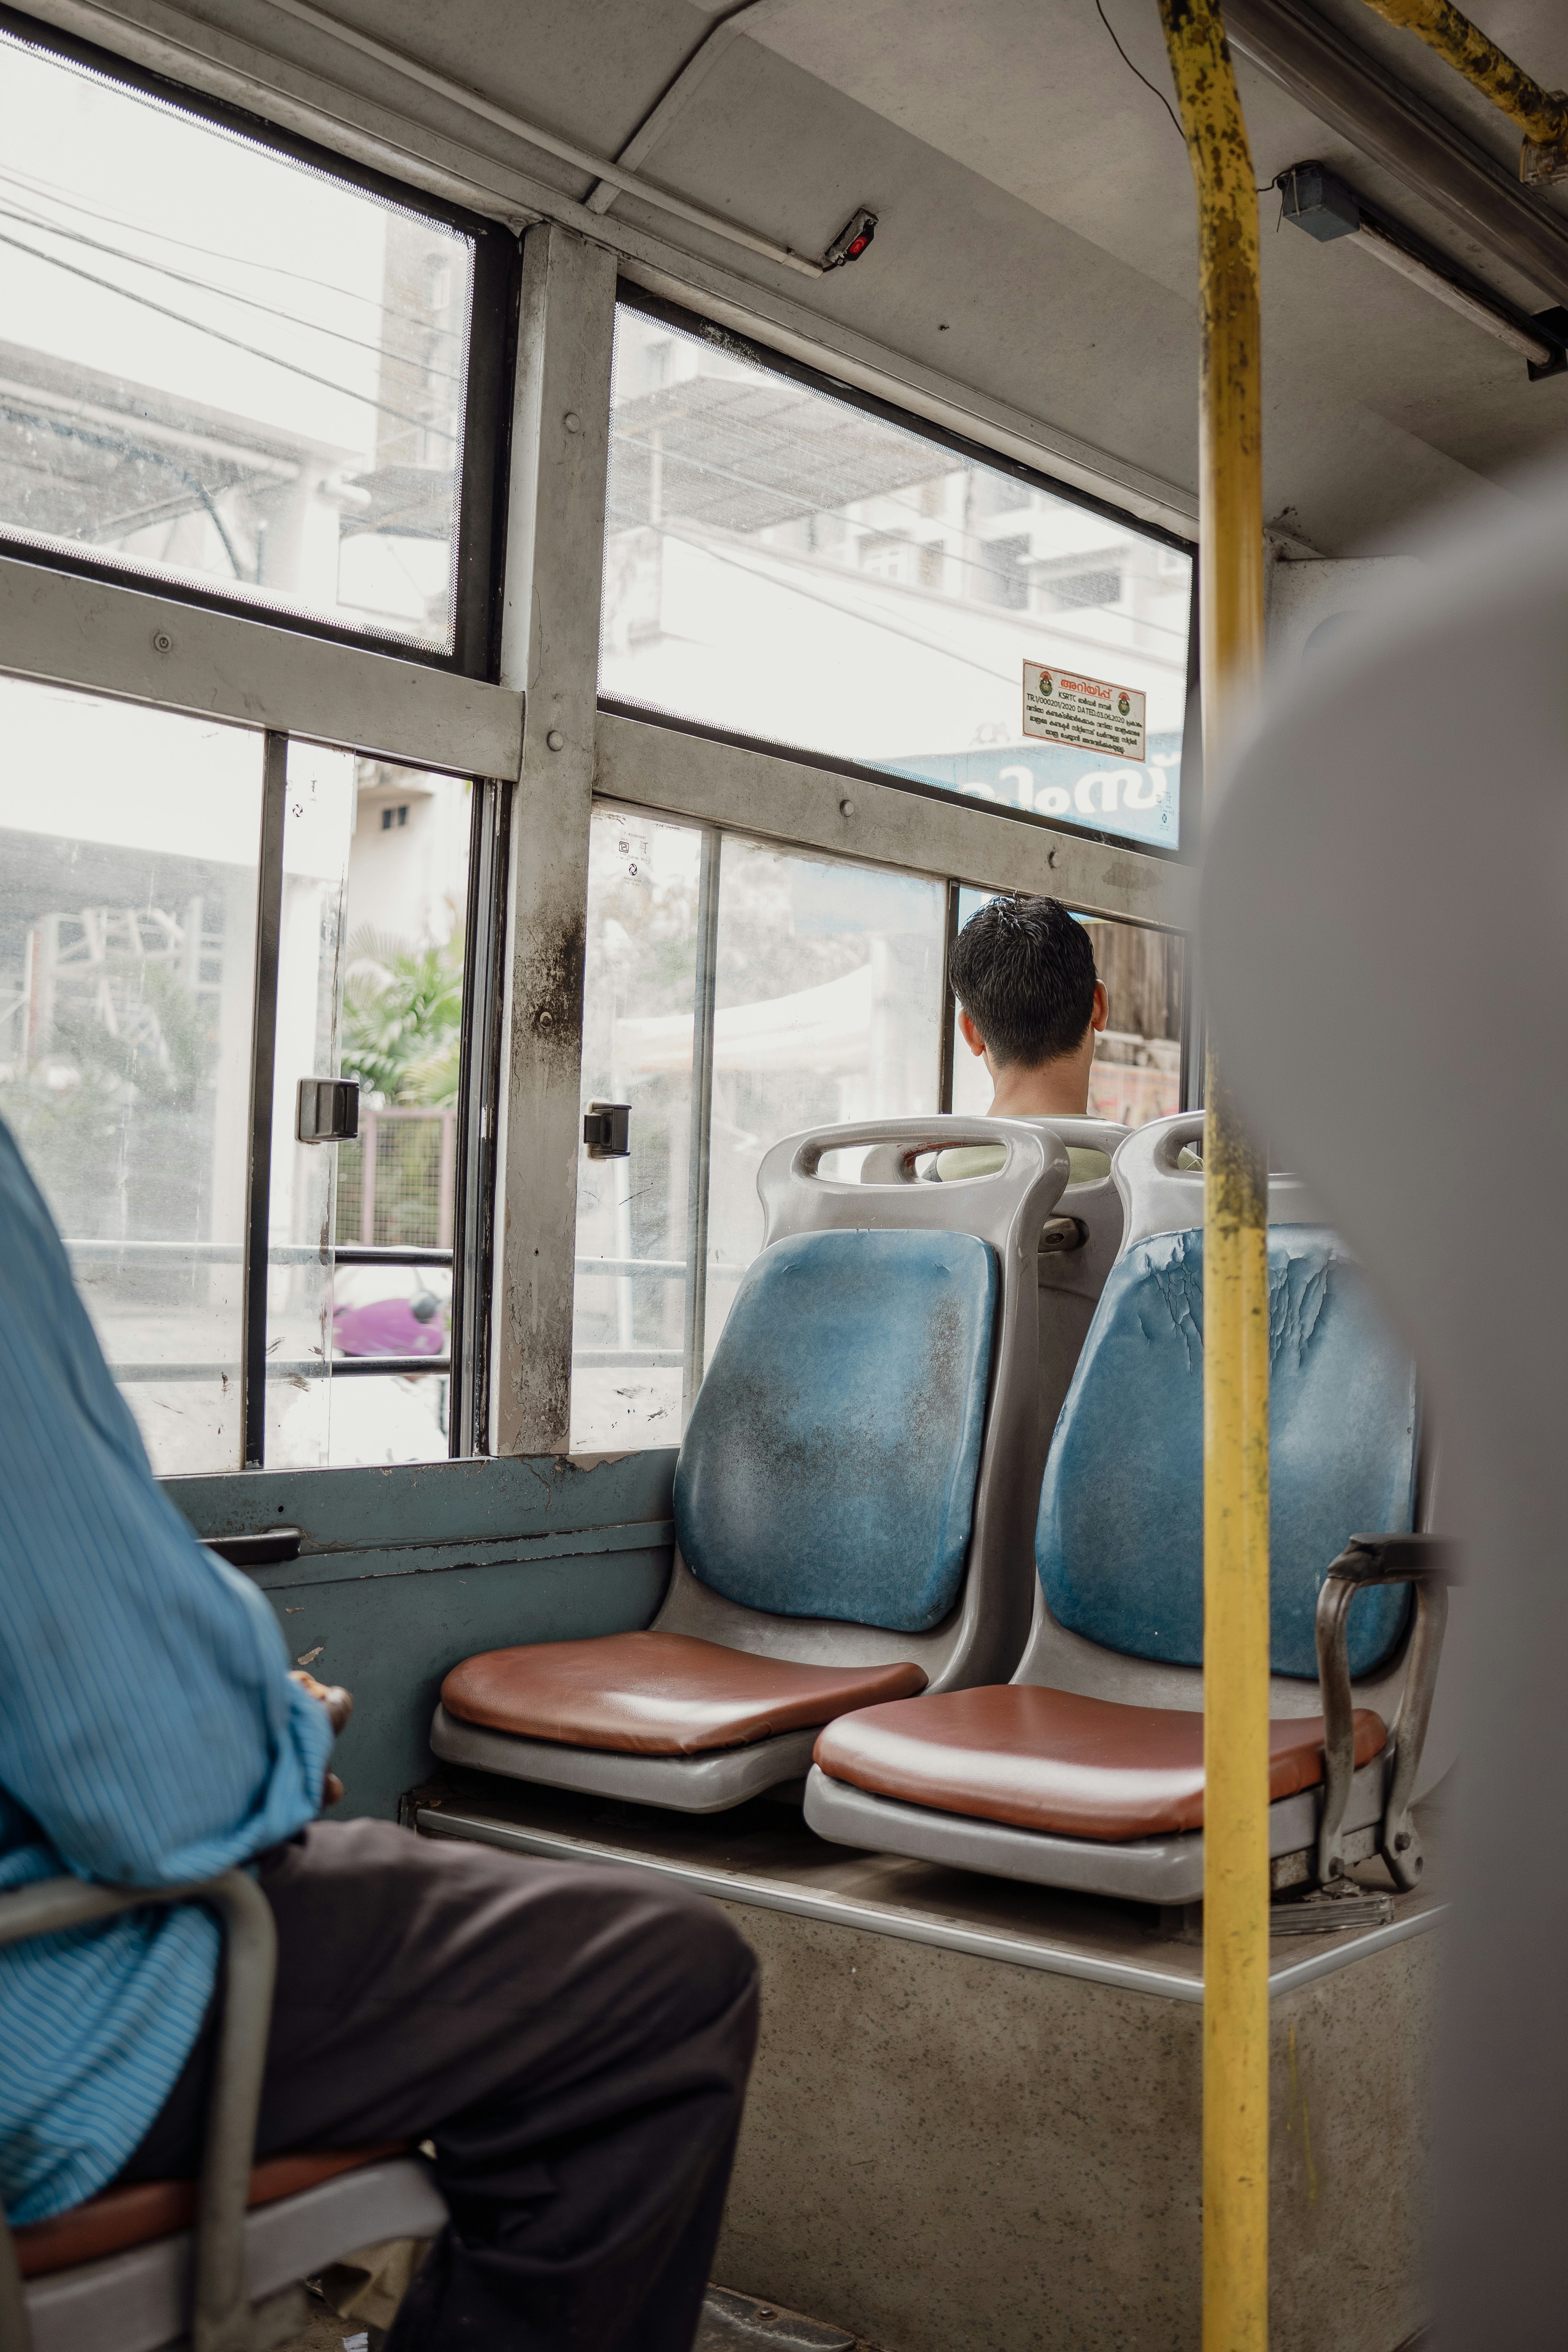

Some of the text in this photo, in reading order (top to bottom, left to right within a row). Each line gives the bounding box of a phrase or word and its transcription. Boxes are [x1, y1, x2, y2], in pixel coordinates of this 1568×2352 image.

[1058, 691, 1076, 702] KSRTC
[1061, 679, 1113, 699] അറിയിപ്പ്
[1026, 705, 1044, 713] വനിതാ
[1096, 722, 1113, 730] വനിതാ
